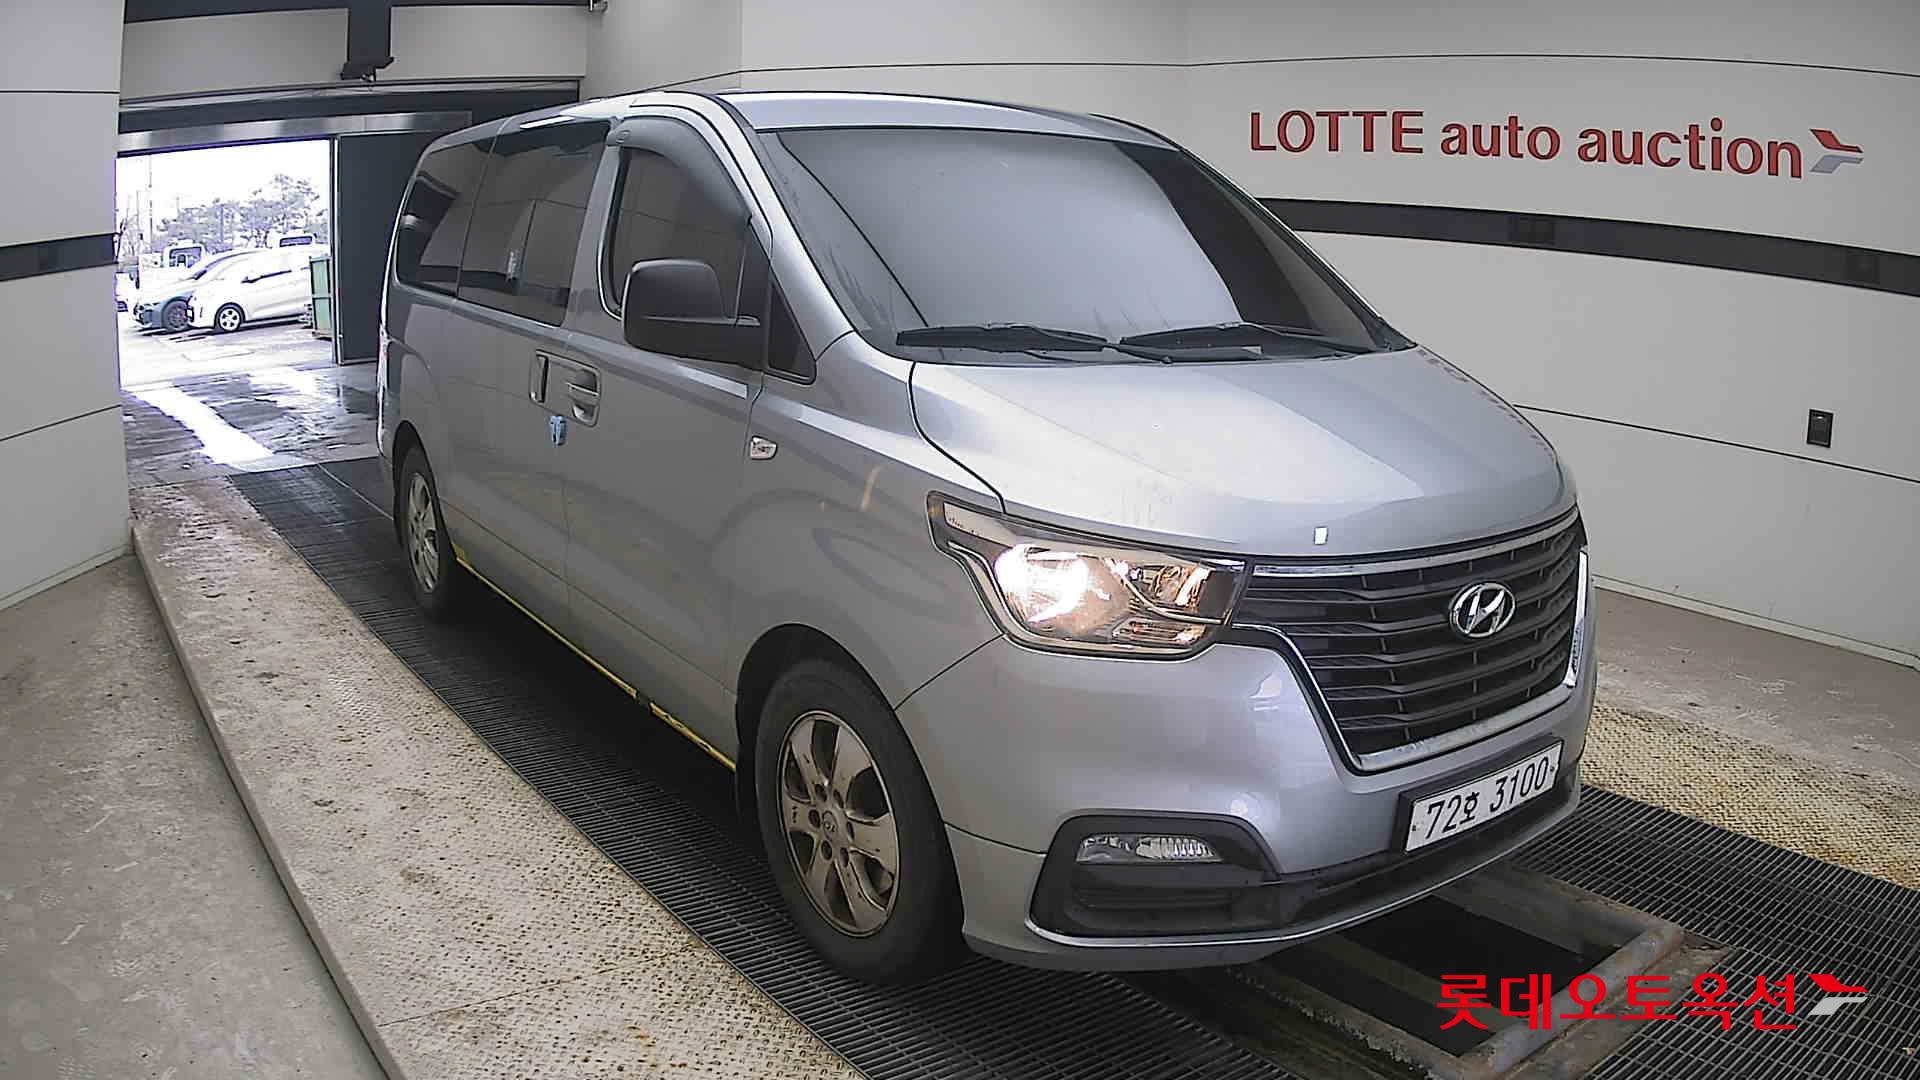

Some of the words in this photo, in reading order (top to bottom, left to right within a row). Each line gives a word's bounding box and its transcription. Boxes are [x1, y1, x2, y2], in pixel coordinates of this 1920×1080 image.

[1250, 110, 1424, 154] LOTTE
[1440, 115, 1561, 160] auto
[1577, 118, 1803, 179] auction
[1425, 791, 1481, 839] 72호
[1489, 756, 1549, 813] 3100
